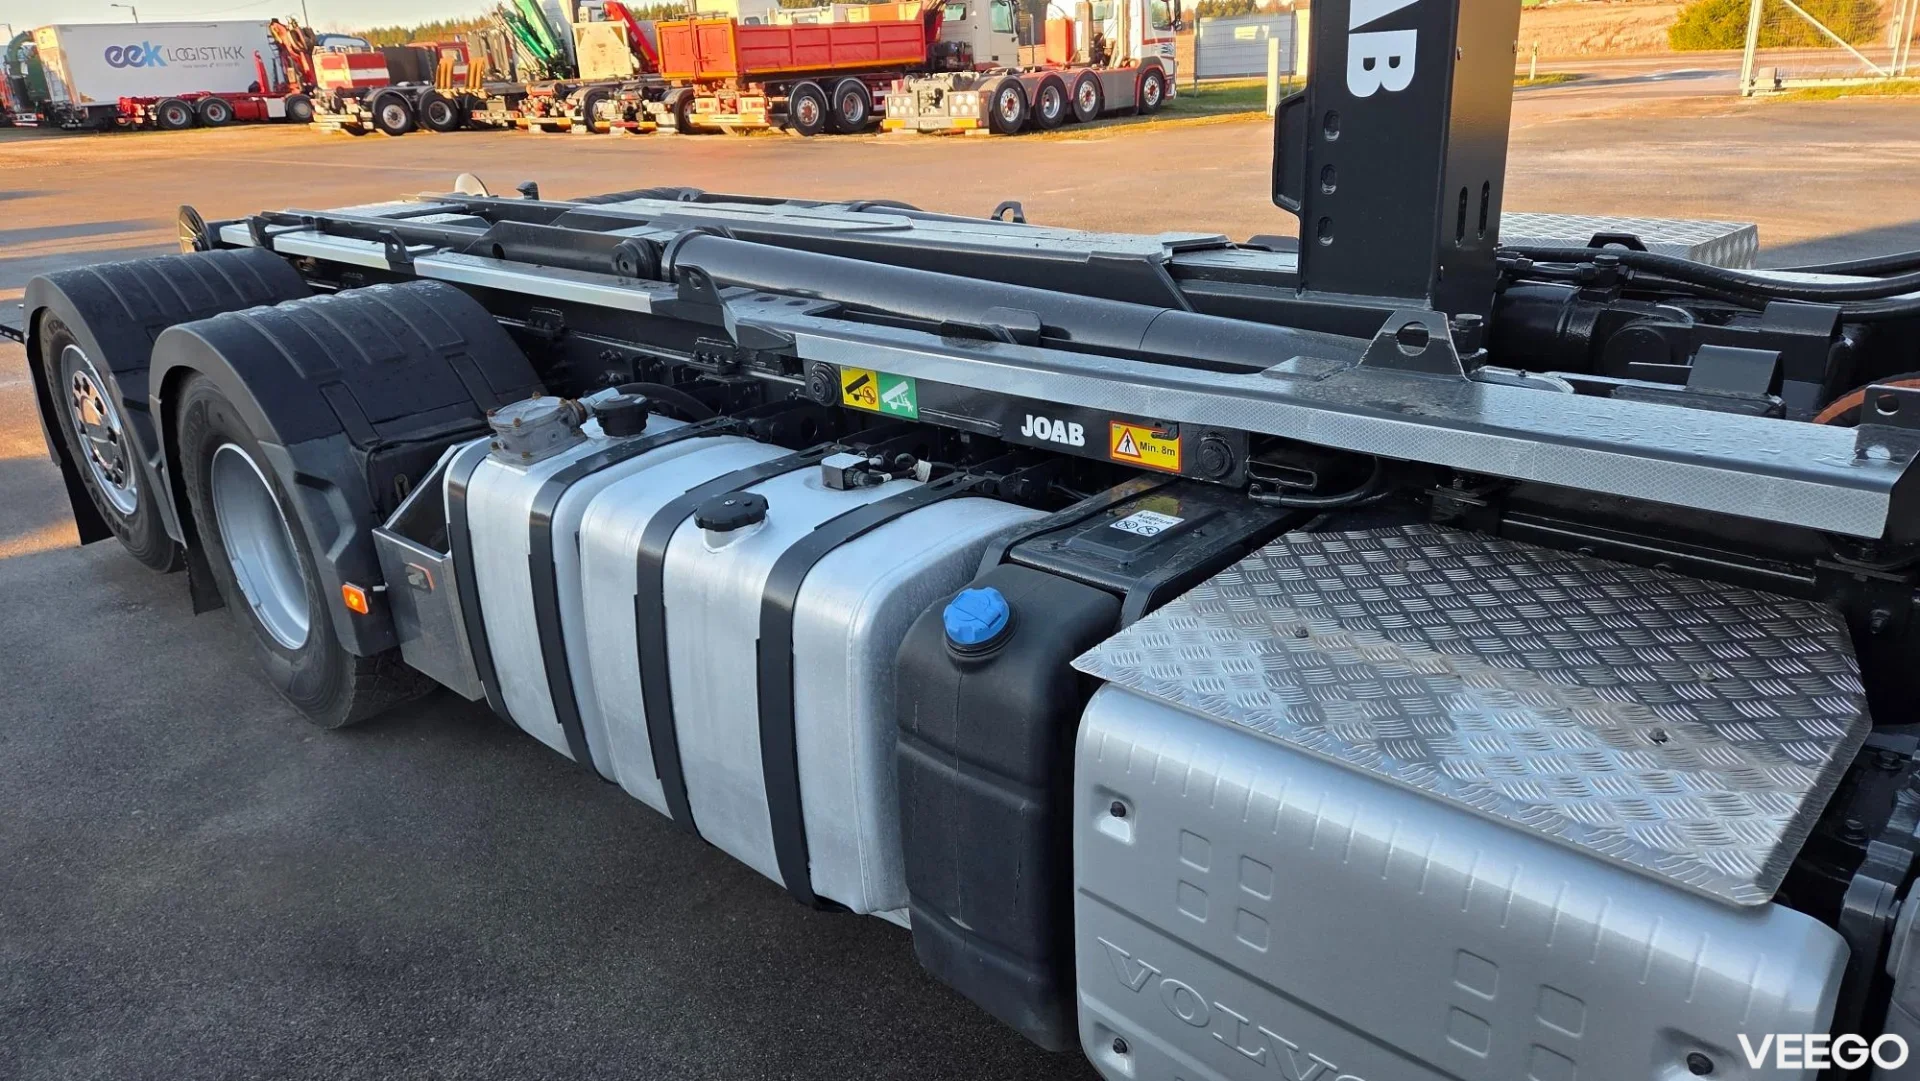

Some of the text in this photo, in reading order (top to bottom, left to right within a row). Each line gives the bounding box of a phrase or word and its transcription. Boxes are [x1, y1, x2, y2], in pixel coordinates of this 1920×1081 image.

[104, 41, 246, 69] eek LOGISTIKK
[1020, 414, 1086, 447] JOAB
[1139, 441, 1176, 457] Min. 8m
[1097, 936, 1367, 1081] VOLV
